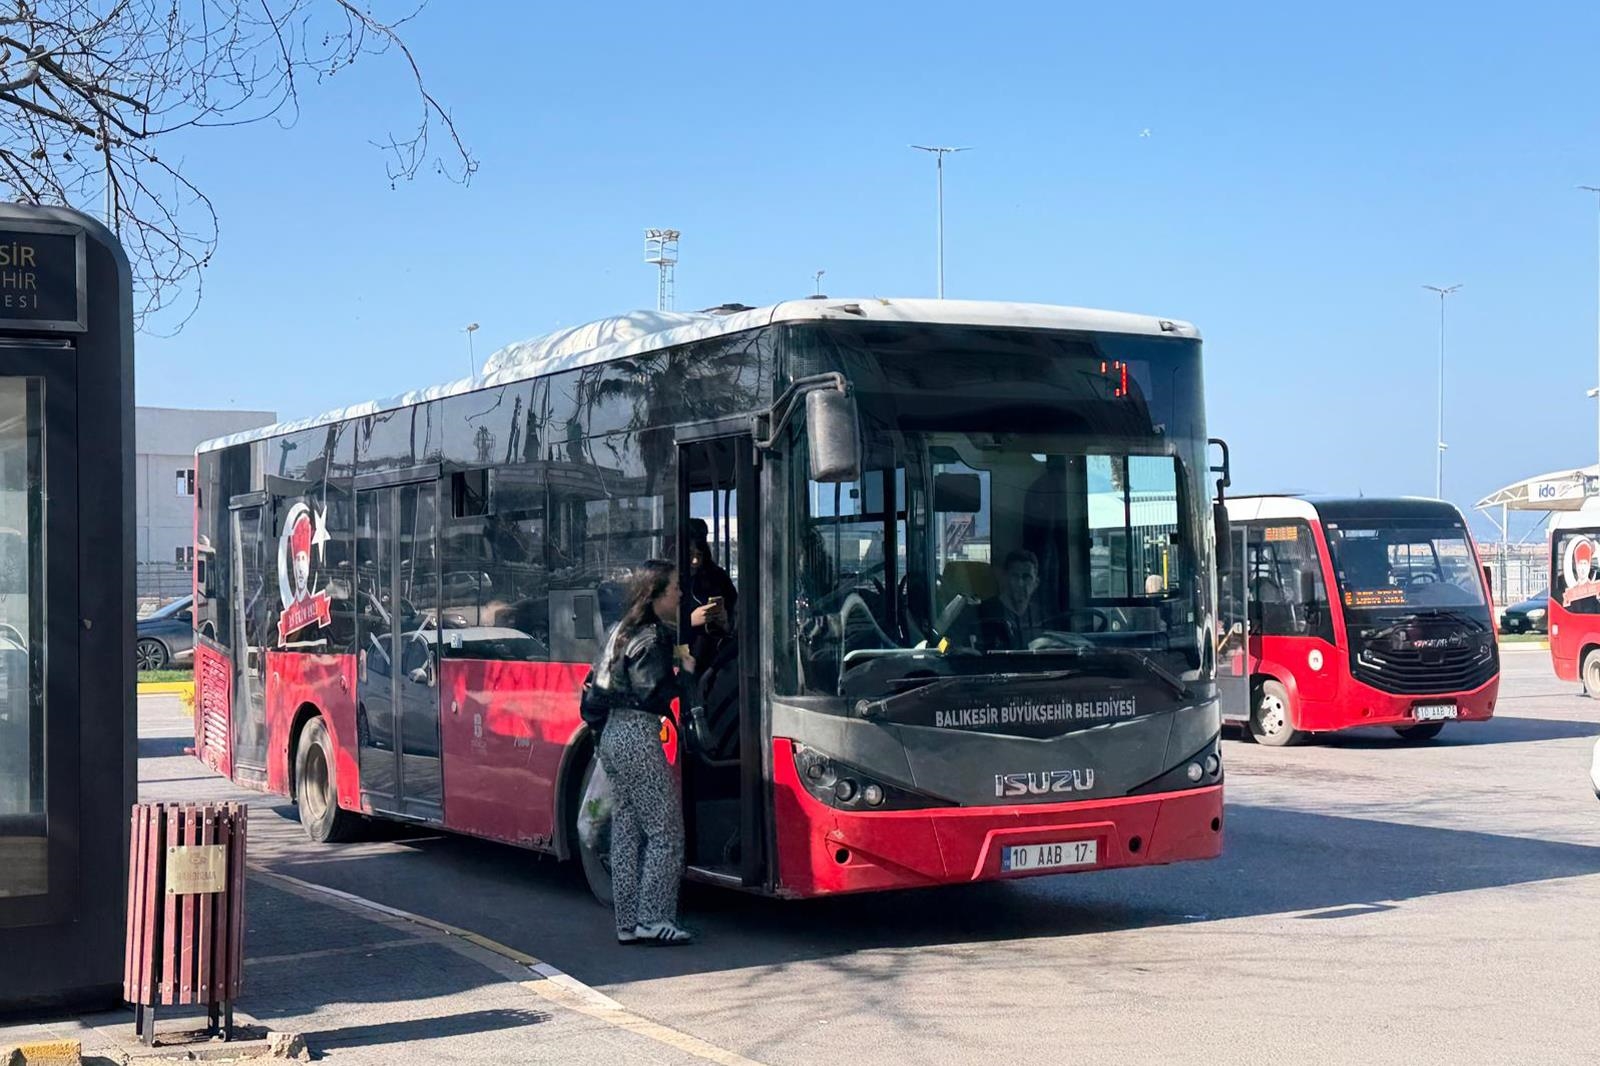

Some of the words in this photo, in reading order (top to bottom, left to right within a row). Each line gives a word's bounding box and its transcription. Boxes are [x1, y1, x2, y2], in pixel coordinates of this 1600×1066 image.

[1538, 483, 1556, 498] ido
[935, 703, 999, 727] BALIKESİR
[1001, 699, 1073, 723] BÜYÜKŞEHİR
[1075, 696, 1136, 719] BELEDİYESİ
[995, 768, 1095, 797] ISUZU
[1013, 848, 1027, 867] 10
[1037, 845, 1062, 866] AAB
[1074, 843, 1088, 862] 17
